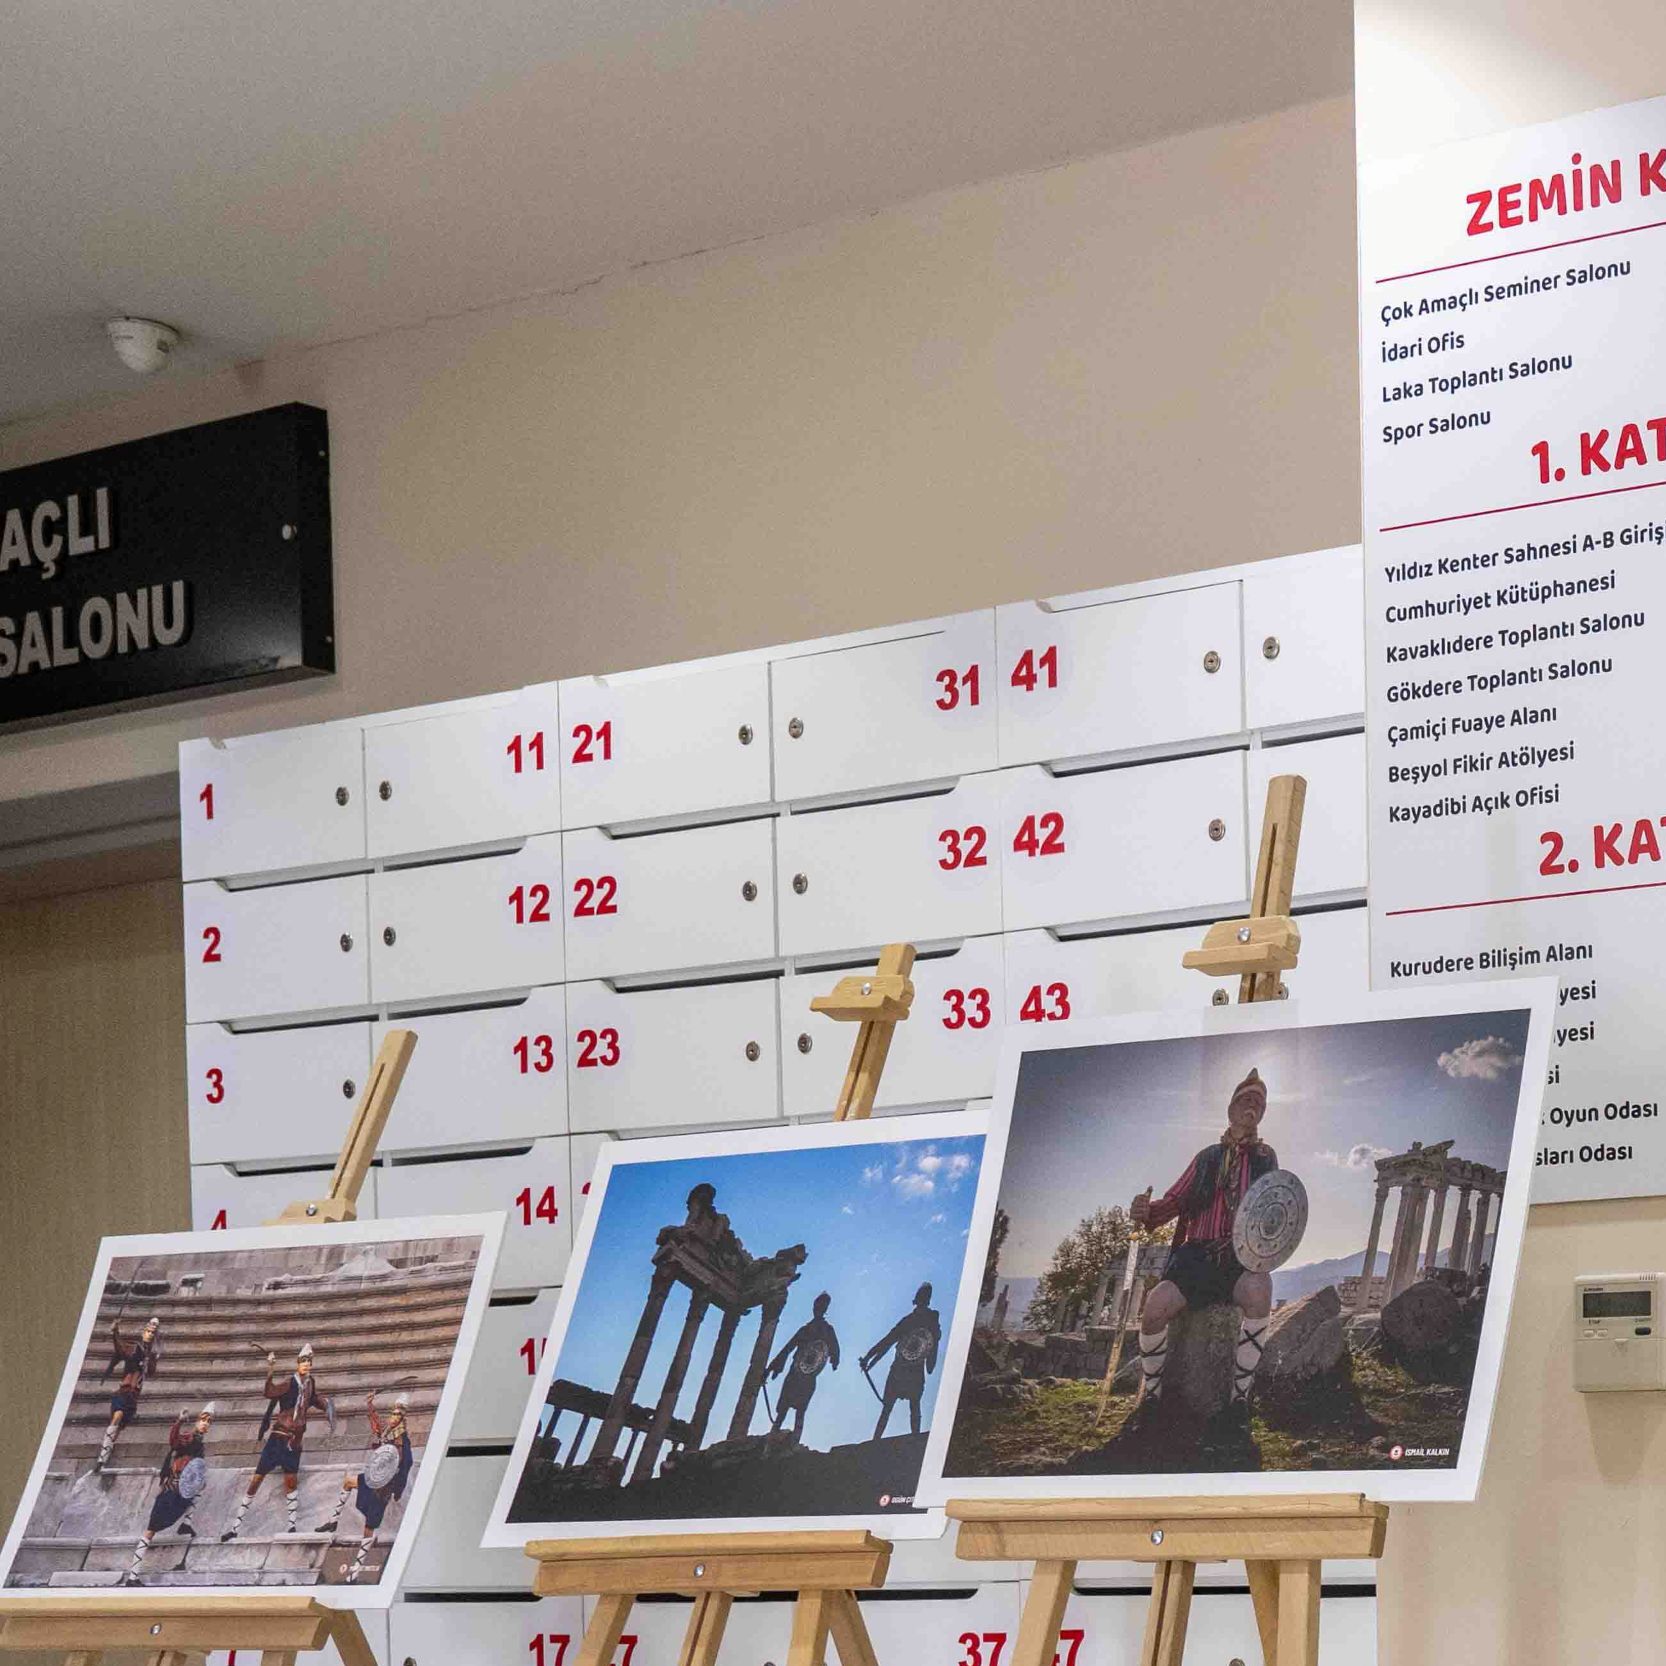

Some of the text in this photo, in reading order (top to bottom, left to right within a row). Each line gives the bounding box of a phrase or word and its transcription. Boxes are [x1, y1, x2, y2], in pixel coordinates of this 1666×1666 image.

[1466, 153, 1622, 236] ZEMİN
[1380, 260, 1631, 327] Çok Amaçlı Seminer Salonu
[1381, 332, 1465, 364] İdari Ofis
[1382, 354, 1573, 403] Laka Toplantı Salonu
[1382, 410, 1491, 446] Spor Salonu
[1531, 440, 1566, 484] 1.
[1384, 561, 1434, 583] Yıldız
[1437, 552, 1500, 576] Kenter
[1503, 533, 1577, 565] Sahnesi
[1582, 530, 1615, 553] A-B
[1385, 568, 1616, 624] Cumhuriyet Kütüphanesi
[0, 579, 186, 679] SALONU
[1386, 611, 1645, 664] Kavaklıdere Toplantı Salonu
[936, 664, 980, 711] 31
[1011, 646, 1058, 692] 41
[1386, 658, 1613, 703] Gökdere Toplantı Salonu
[572, 721, 612, 764] 21
[1387, 706, 1557, 748] Çamiçi Fuaye Alanı
[506, 733, 545, 773] 11
[1388, 739, 1575, 785] Beşyol Fikir Atölyesi
[200, 784, 214, 819] 1
[1389, 782, 1560, 825] Kayadibi Açık Ofisi
[938, 825, 988, 870] 32
[1013, 812, 1066, 857] 42
[1539, 831, 1579, 876] 2.
[508, 884, 550, 924] 12
[573, 875, 618, 917] 22
[202, 926, 222, 962] 2
[1390, 942, 1593, 979] Kurudere Bilişim Alanı
[942, 987, 991, 1030] 33
[1020, 982, 1071, 1022] 43
[513, 1034, 554, 1073] 13
[577, 1028, 620, 1067] 23
[1553, 1020, 1595, 1048] yesi
[206, 1069, 224, 1104] 3
[1549, 1106, 1600, 1129] Oyun
[1603, 1100, 1659, 1121] Odası
[1578, 1142, 1633, 1163] Odası
[516, 1186, 558, 1226] 14
[520, 1338, 547, 1376] 1
